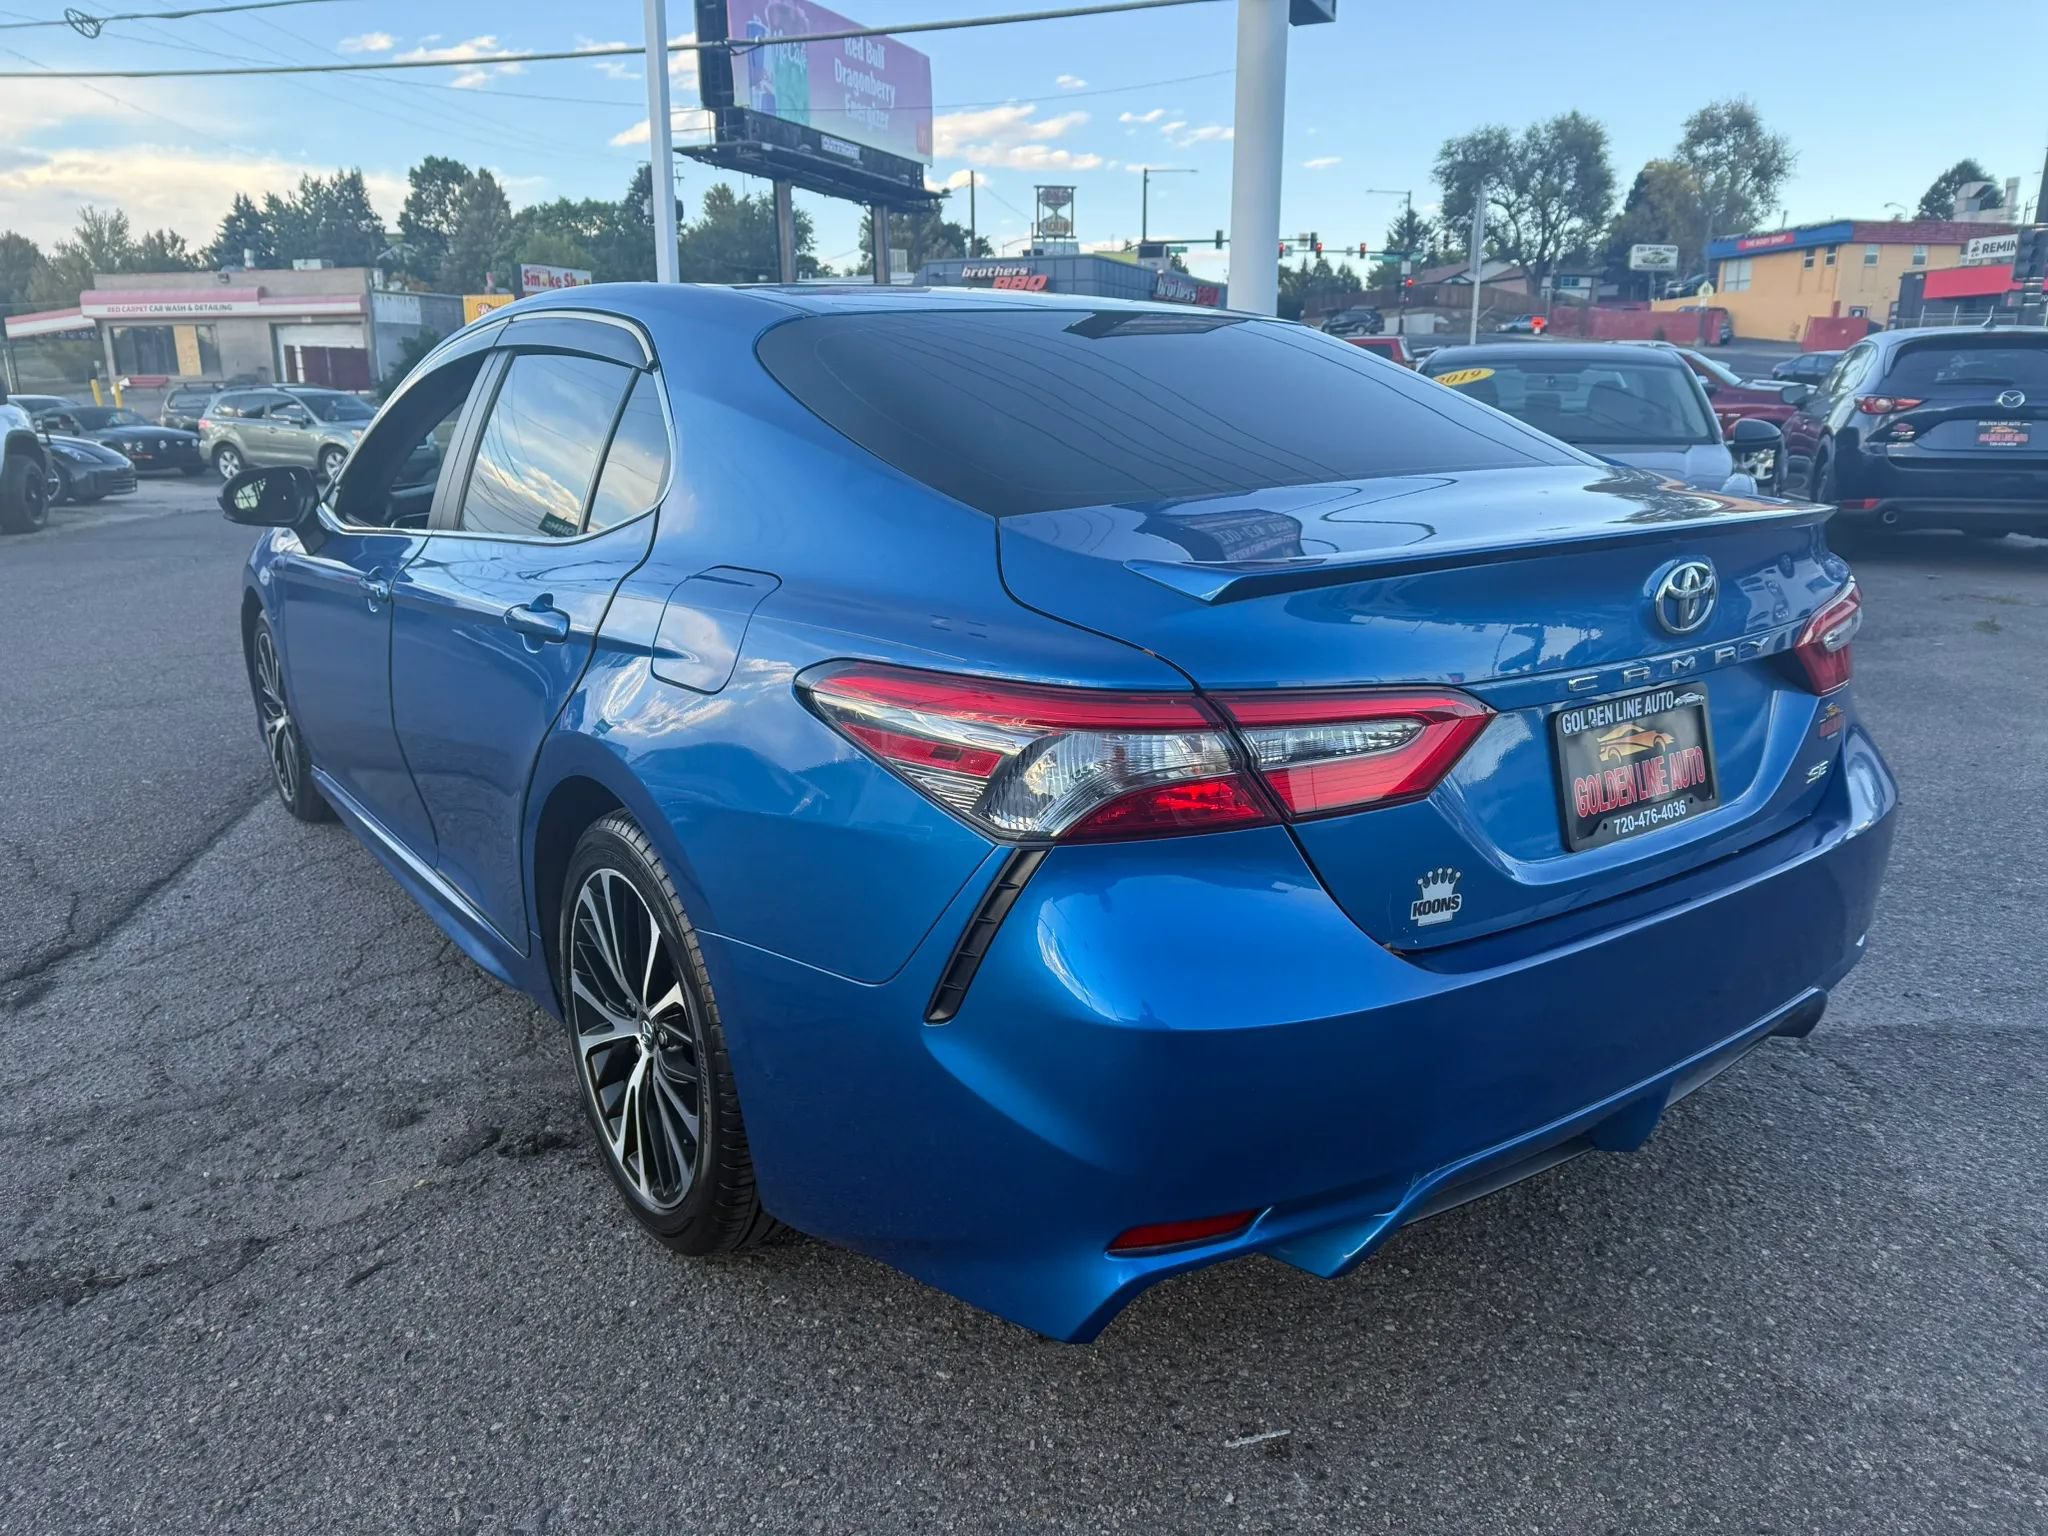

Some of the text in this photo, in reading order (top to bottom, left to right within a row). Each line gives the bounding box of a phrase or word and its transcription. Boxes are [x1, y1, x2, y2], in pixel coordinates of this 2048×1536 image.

[845, 36, 886, 70] Red Bull
[834, 57, 896, 109] Dragonberry
[845, 94, 889, 131] Energizer
[523, 269, 562, 288] Smoke
[962, 265, 1029, 278] brothers
[1157, 274, 1197, 302] brothers
[122, 305, 148, 313] CARPET
[149, 304, 163, 312] CAR
[165, 304, 187, 312] WASH
[194, 303, 233, 312] DETAILING
[1568, 637, 1770, 692] CAMRY
[1562, 690, 1675, 735] GOLDEN LINE AUTO
[1574, 746, 1706, 818] GOLDEN LINE AUTO
[1806, 760, 1829, 784] SE
[1614, 800, 1687, 836] 720-476-4036
[1412, 895, 1461, 918] KOONS
